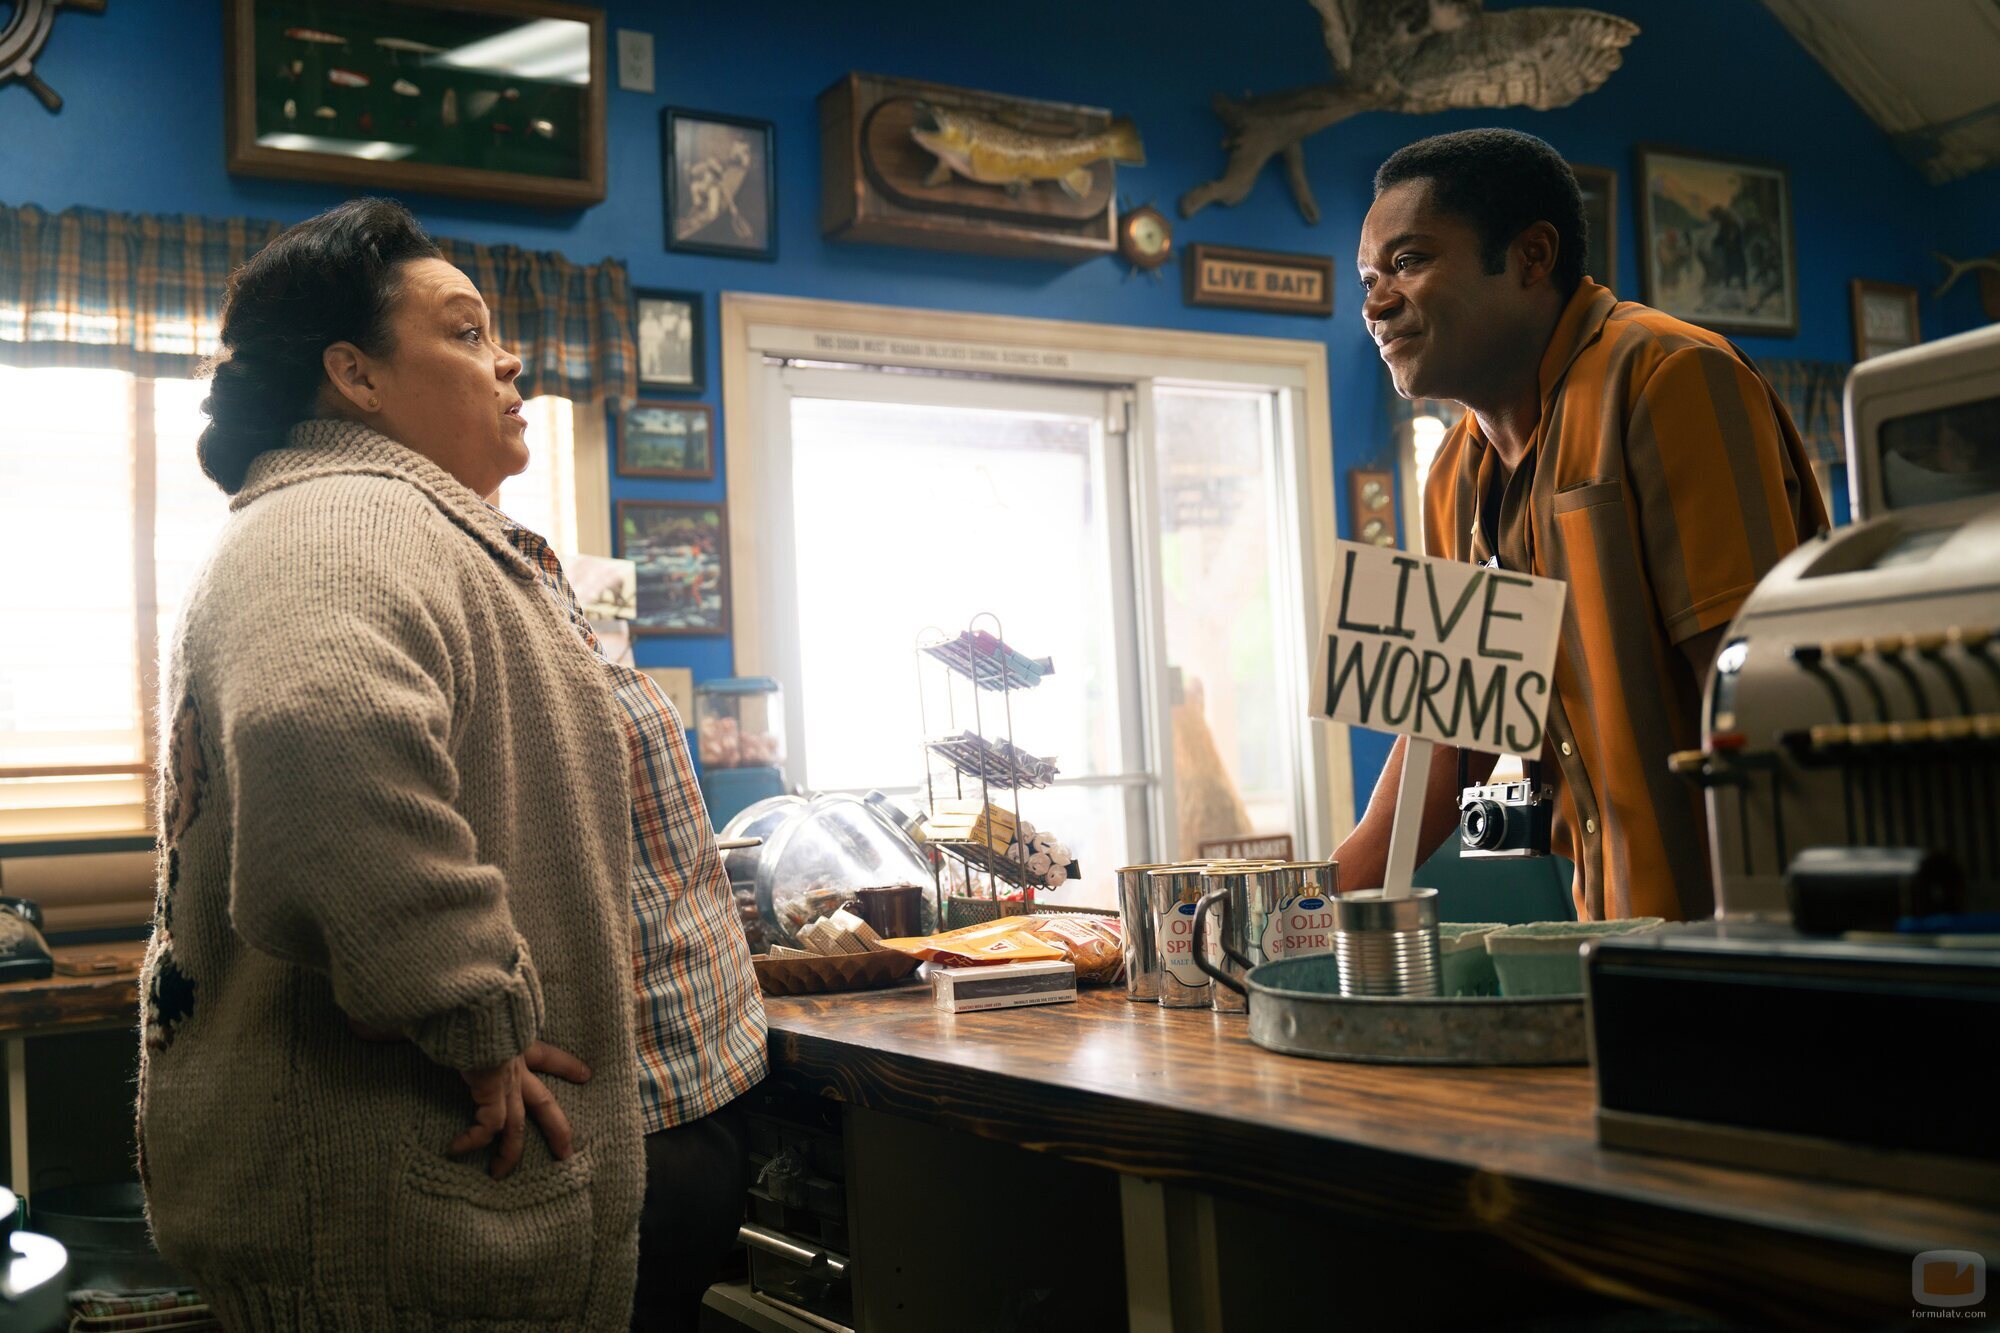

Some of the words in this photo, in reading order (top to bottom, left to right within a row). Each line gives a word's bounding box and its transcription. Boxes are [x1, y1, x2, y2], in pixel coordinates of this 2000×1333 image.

[1207, 266, 1256, 290] LIVE
[1265, 272, 1316, 295] BAIT
[1337, 550, 1533, 661] LIVE
[1325, 633, 1546, 752] WORMS
[1291, 913, 1333, 930] OLD
[1286, 934, 1330, 949] SPIR
